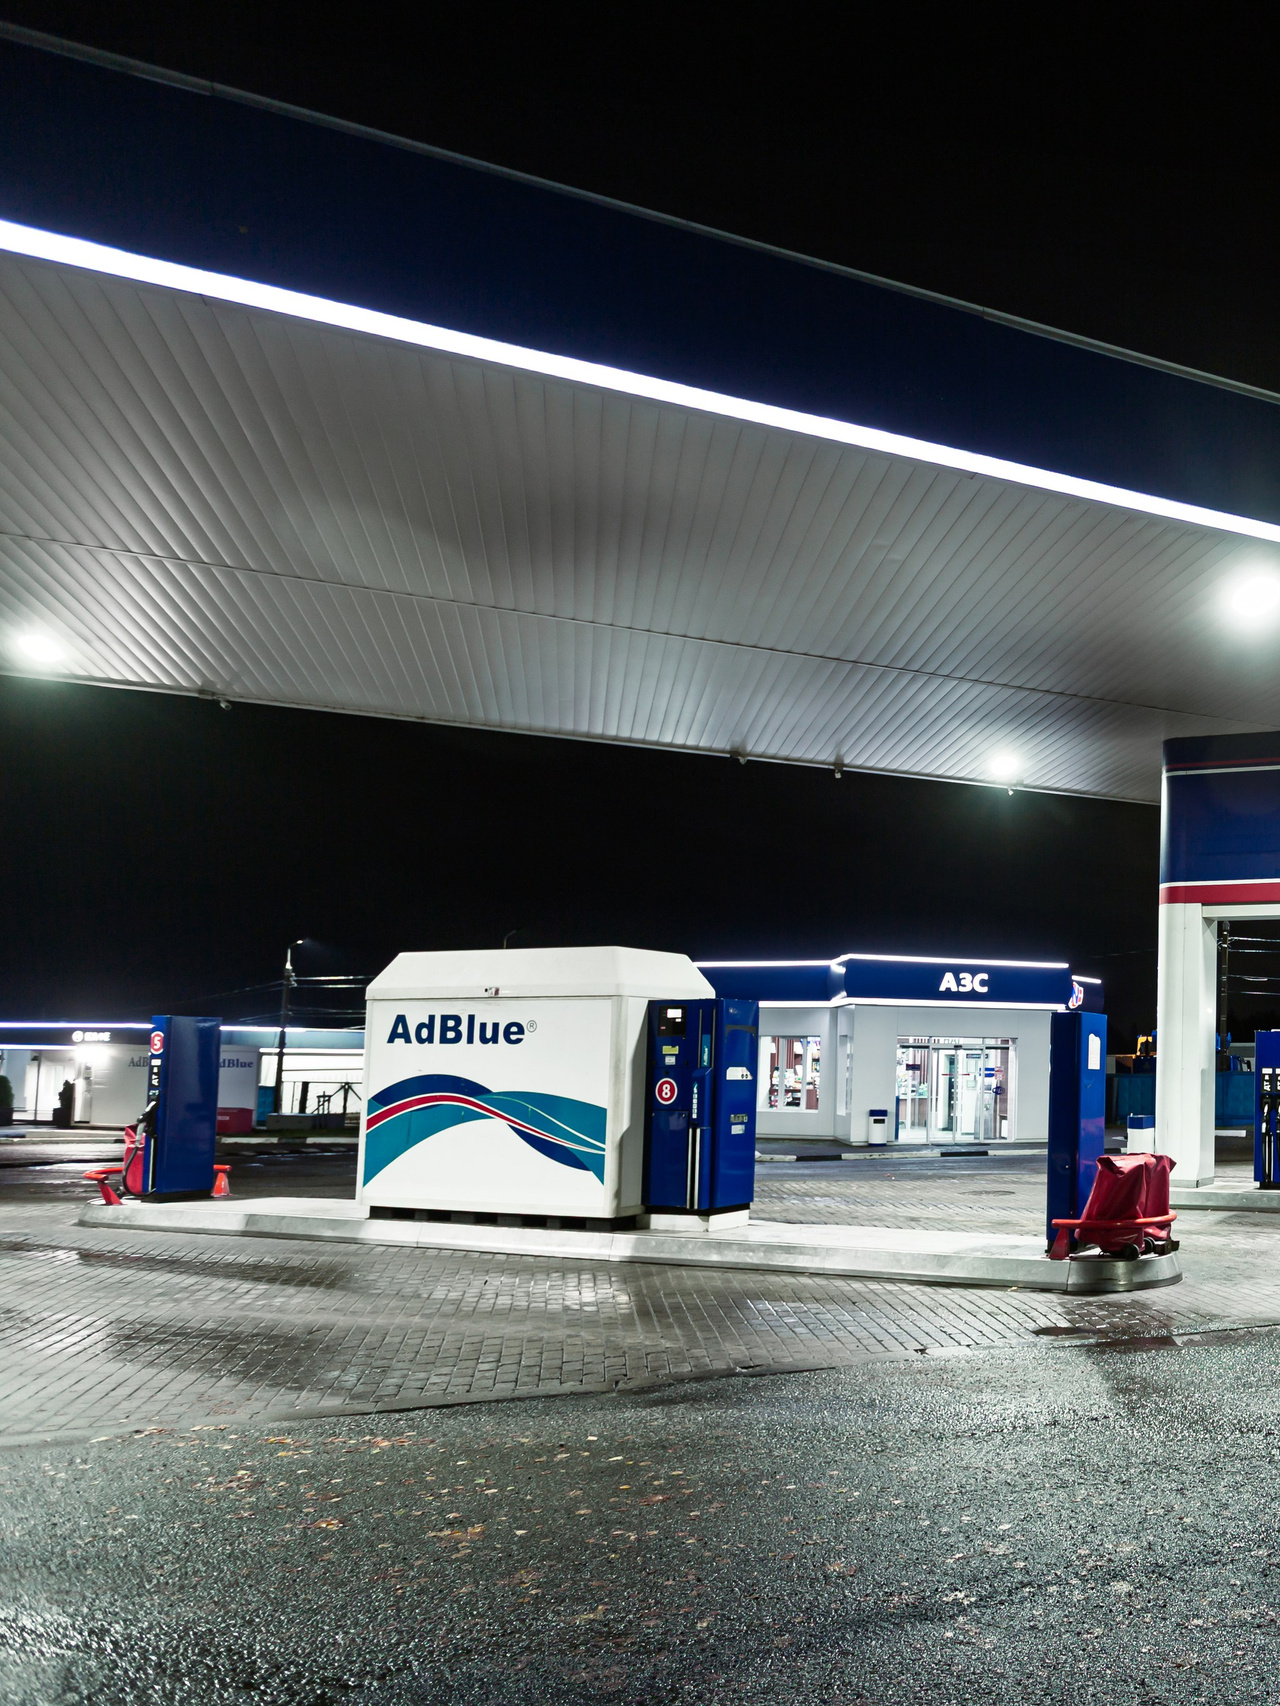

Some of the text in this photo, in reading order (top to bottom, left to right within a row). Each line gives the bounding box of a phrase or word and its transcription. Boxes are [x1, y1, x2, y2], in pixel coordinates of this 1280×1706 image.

[939, 972, 989, 993] АЗС
[153, 1037, 160, 1049] 5
[129, 1057, 149, 1067] AdB
[219, 1058, 254, 1068] dBlue
[662, 1084, 671, 1098] 8
